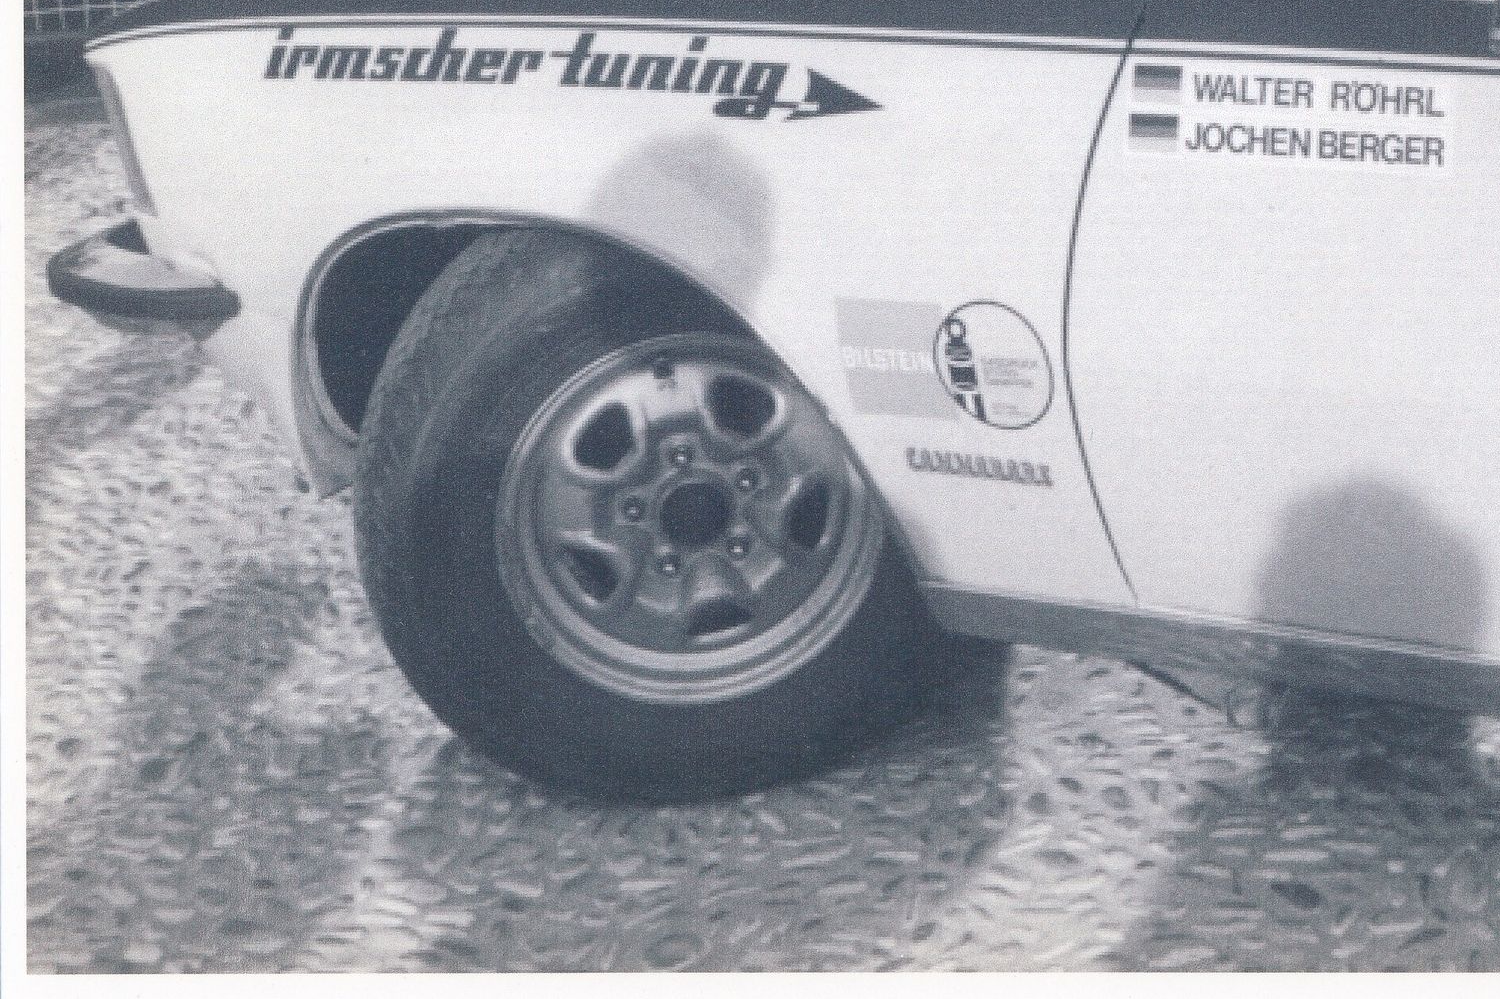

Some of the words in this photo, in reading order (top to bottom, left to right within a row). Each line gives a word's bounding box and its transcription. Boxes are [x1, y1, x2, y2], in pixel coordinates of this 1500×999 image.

[264, 25, 543, 83] irmscher
[551, 32, 788, 120] tuning
[1194, 72, 1314, 108] WALTER
[1330, 79, 1445, 117] RÖHRL
[1185, 122, 1311, 156] JOCHEN
[1318, 130, 1445, 166] BERGER
[841, 344, 935, 371] BILSTEIN
